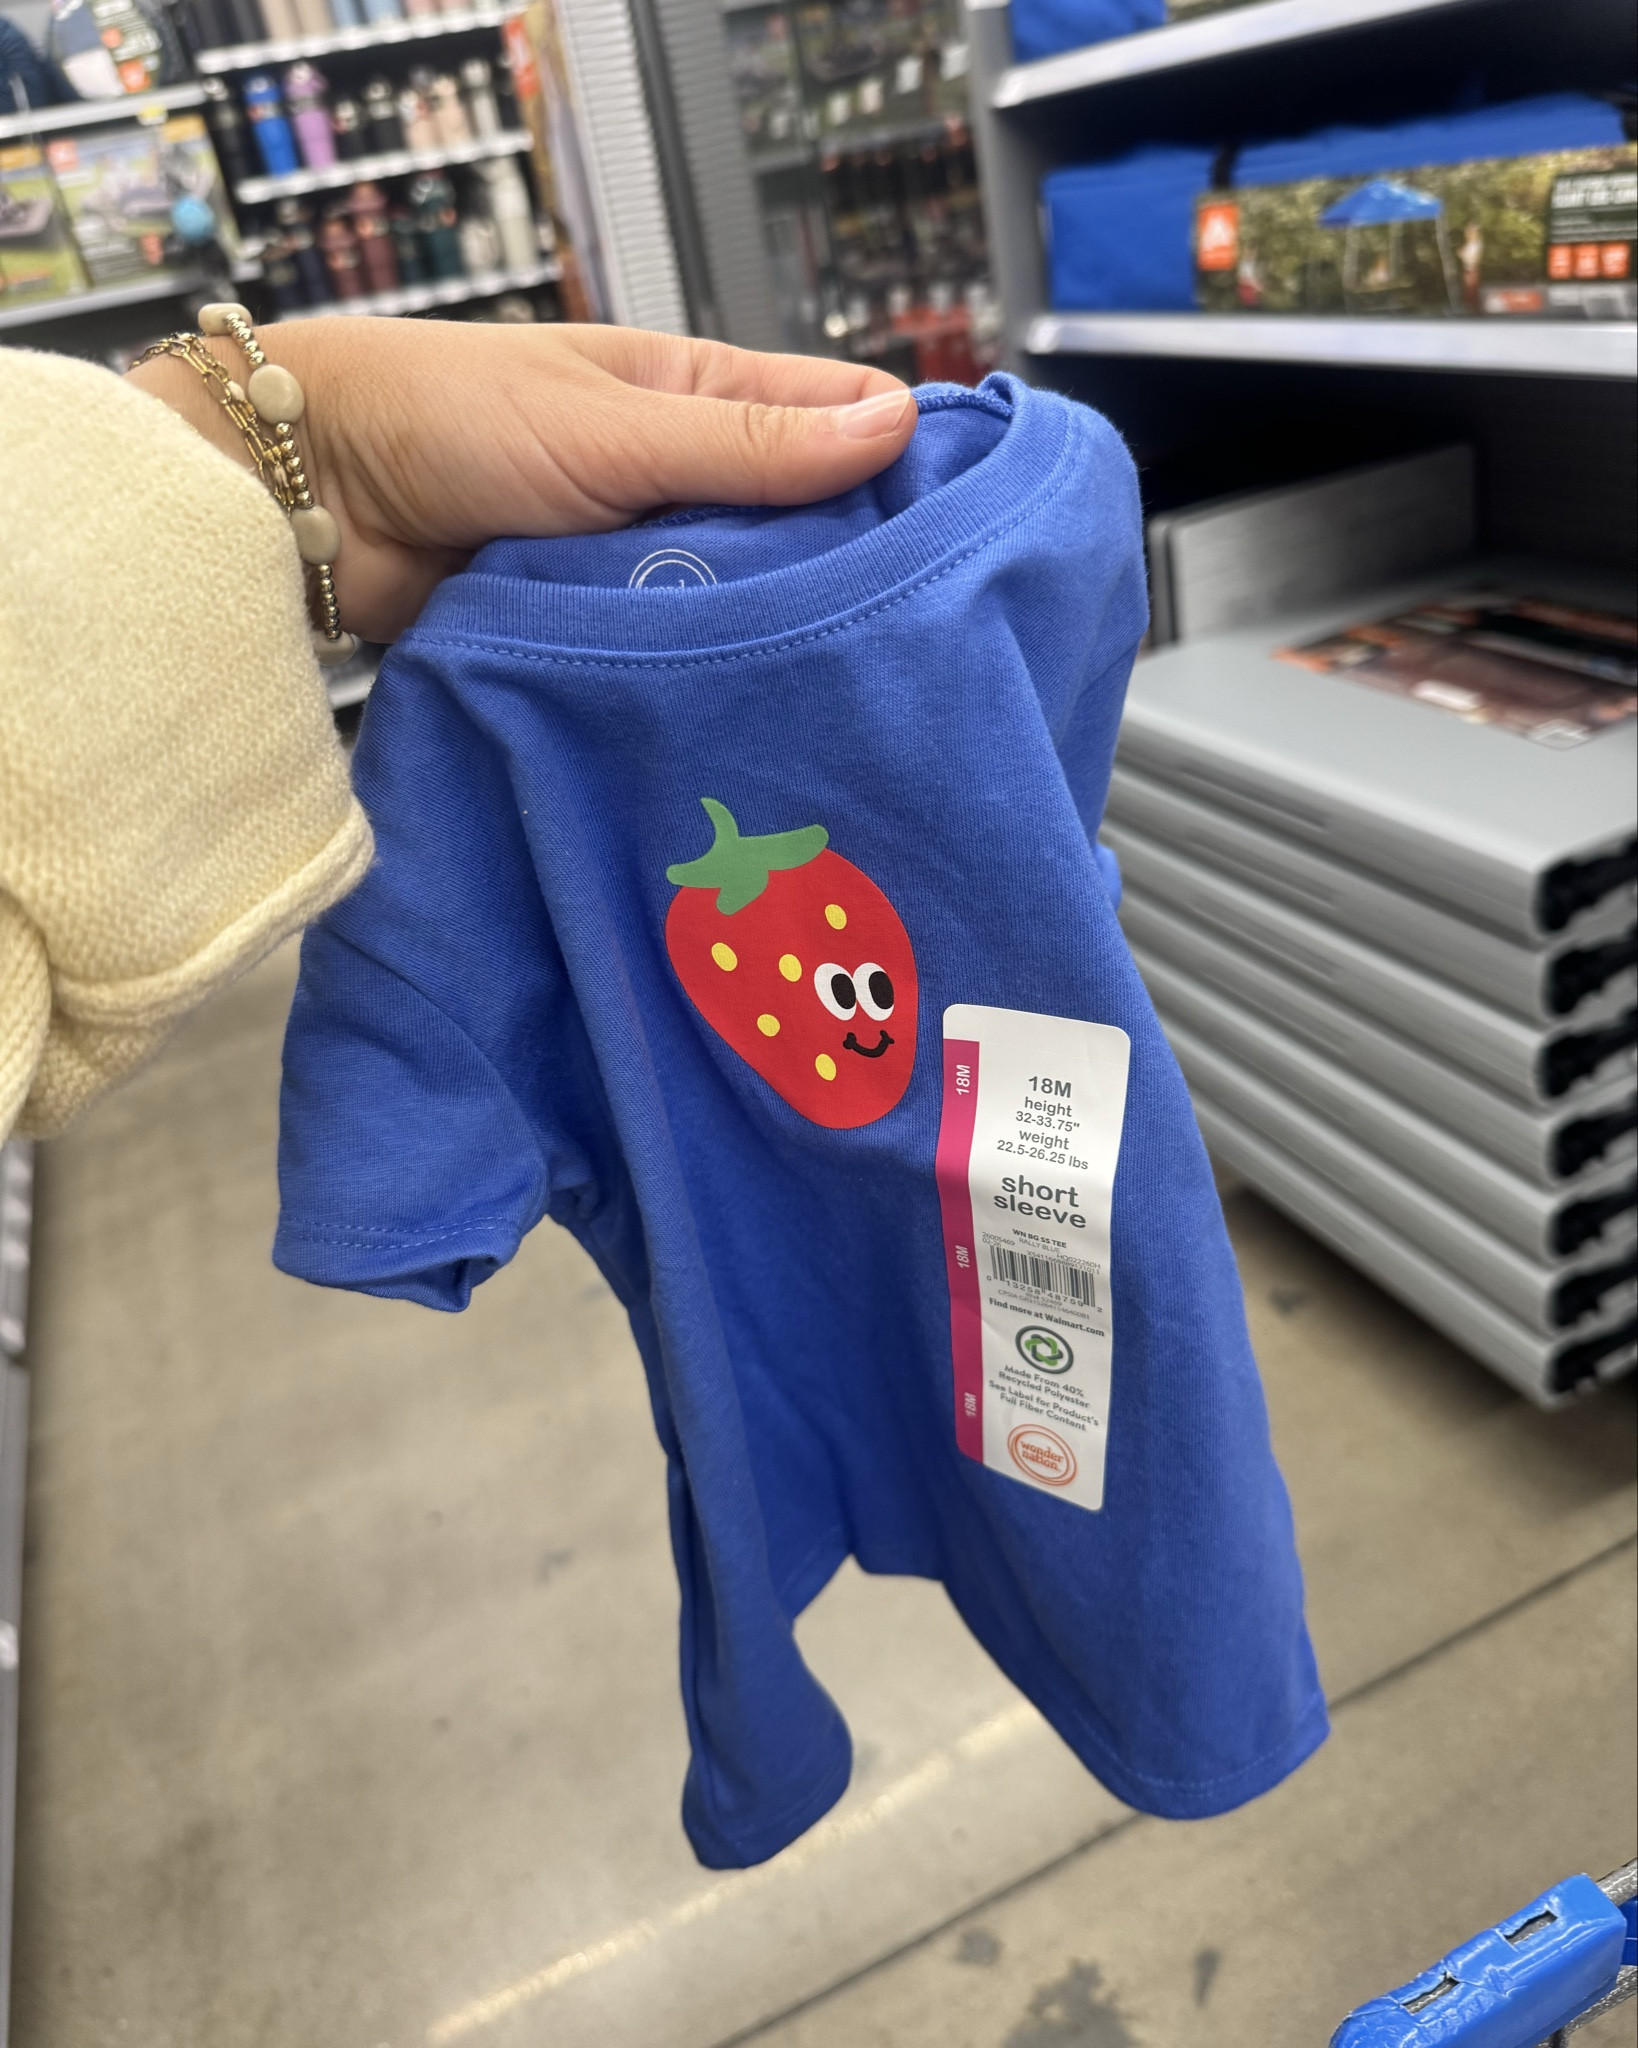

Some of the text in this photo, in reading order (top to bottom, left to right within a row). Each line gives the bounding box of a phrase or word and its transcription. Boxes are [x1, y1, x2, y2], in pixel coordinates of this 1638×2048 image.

[956, 1064, 971, 1096] 18M
[1028, 1076, 1072, 1098] 18M
[1024, 1096, 1072, 1118] height
[1015, 1110, 1080, 1132] 32-33.75"
[1019, 1129, 1070, 1150] weight
[996, 1139, 1089, 1170] 22.5-26.25 lbs
[1001, 1174, 1079, 1208] short
[993, 1194, 1087, 1229] sleeve
[1012, 1228, 1067, 1249] WN BG SS TEE
[1019, 1237, 1061, 1254] RALLY BLUE
[956, 1244, 970, 1269] 18M
[989, 1297, 1008, 1309] Find
[1009, 1304, 1033, 1316] more
[1033, 1311, 1044, 1320] at
[1044, 1312, 1105, 1337] Walmart.com
[998, 1371, 1090, 1408] Recycled Polyester
[1004, 1365, 1084, 1397] Made From 40%
[964, 1391, 977, 1418] 18M
[988, 1379, 1100, 1426] See Label for Product's
[1000, 1392, 1087, 1431] Full Fiber Content
[1020, 1440, 1064, 1462] wonder
[1021, 1450, 1058, 1471] nation
